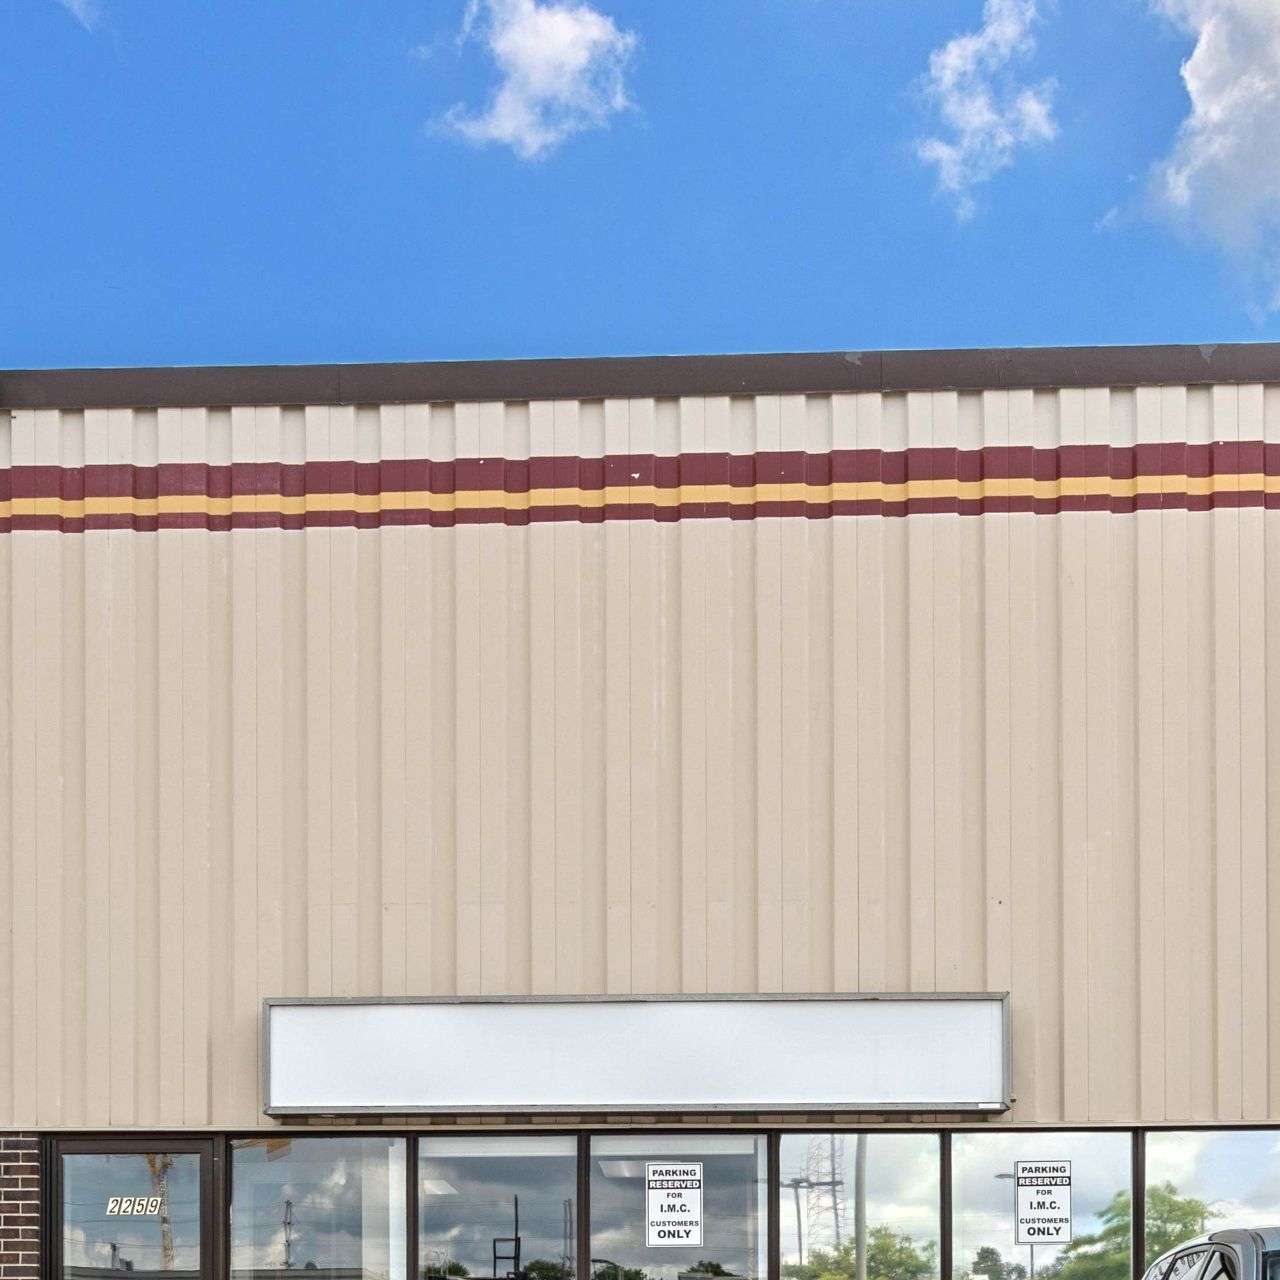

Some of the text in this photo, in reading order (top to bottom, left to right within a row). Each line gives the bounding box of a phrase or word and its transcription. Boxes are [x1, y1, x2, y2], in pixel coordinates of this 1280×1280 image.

[652, 1169, 697, 1177] PARKING
[1022, 1166, 1066, 1174] PARKING
[649, 1180, 700, 1188] RESERVED
[1019, 1177, 1070, 1186] RESERVED
[108, 1198, 159, 1214] 2259
[660, 1203, 690, 1213] I.M.C.
[1029, 1201, 1060, 1210] I.M.C.
[657, 1229, 692, 1238] ONLY
[1027, 1226, 1061, 1236] ONLY
